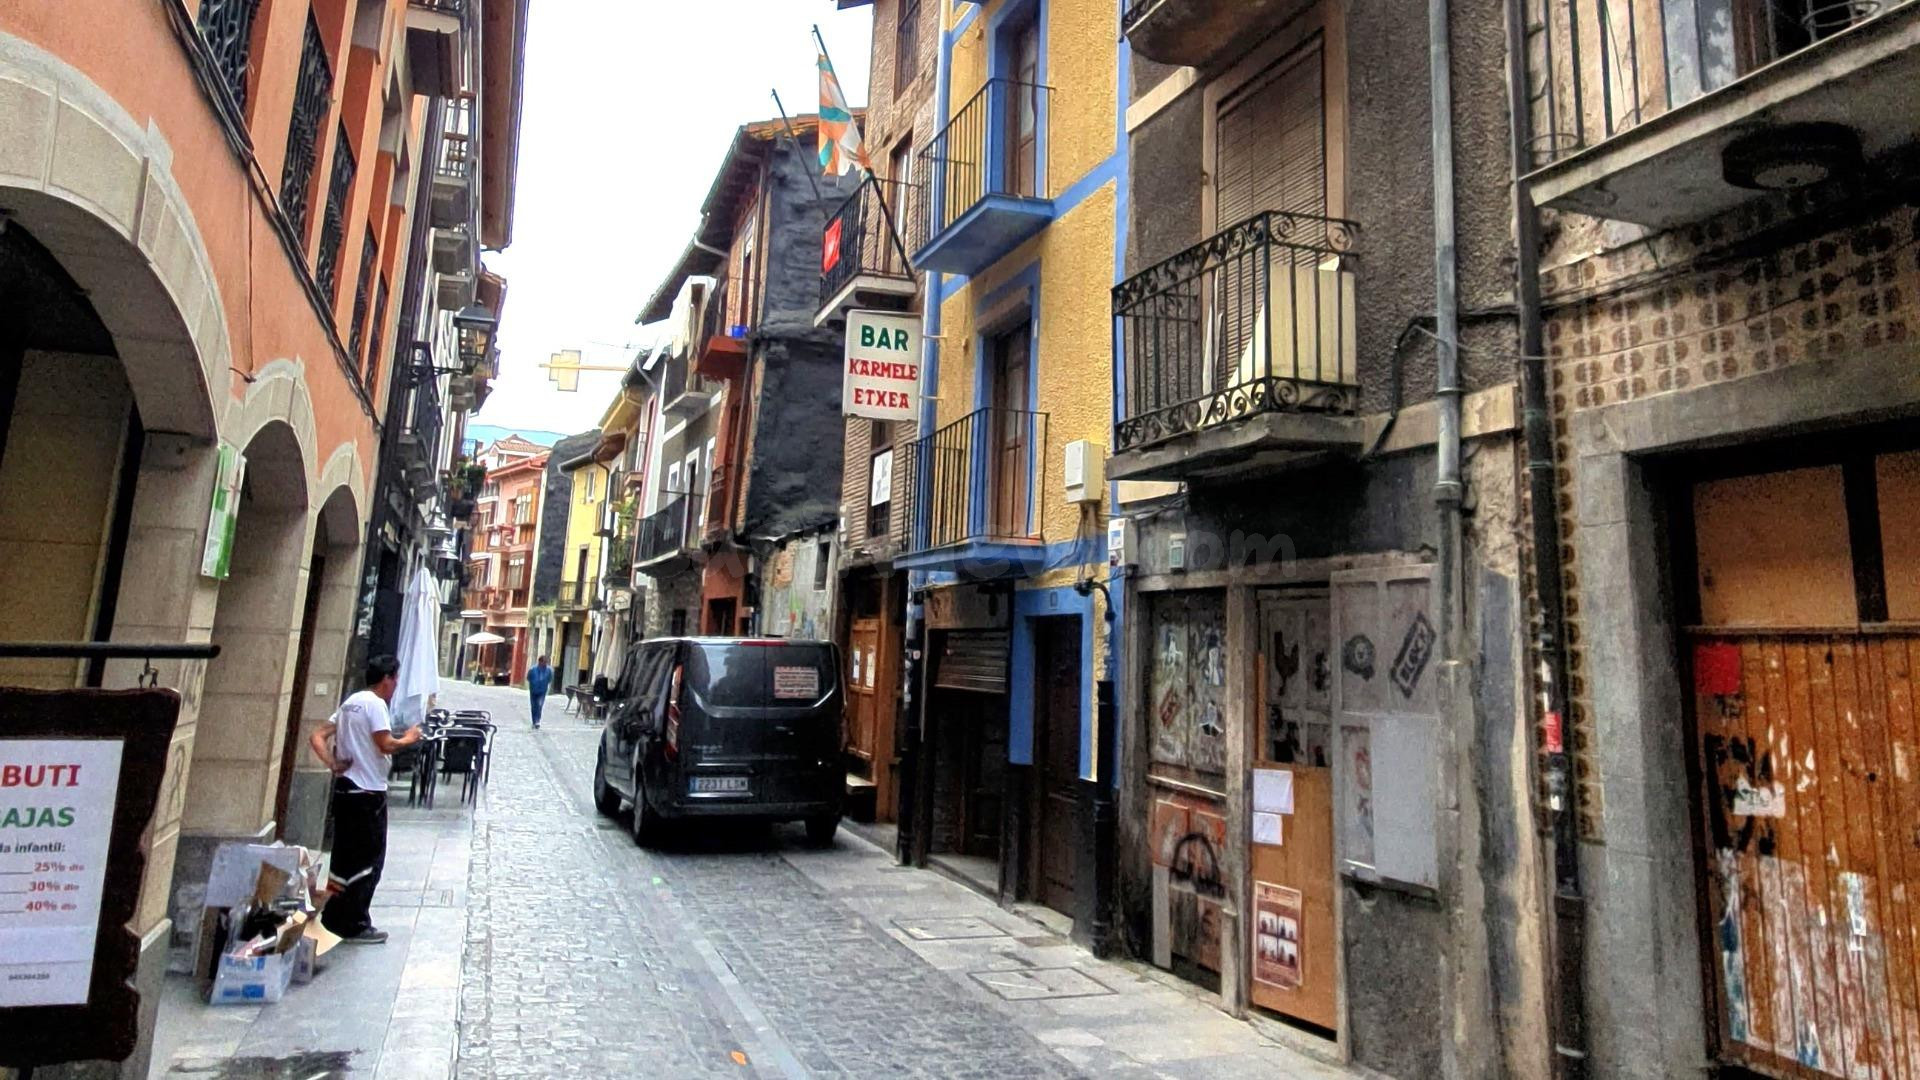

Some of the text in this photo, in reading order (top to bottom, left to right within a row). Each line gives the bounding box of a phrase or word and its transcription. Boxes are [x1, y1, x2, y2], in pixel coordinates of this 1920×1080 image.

[861, 324, 909, 351] BAR
[849, 358, 918, 381] KARMELE
[854, 387, 910, 409] ETXEA
[1, 764, 82, 787] BUTI
[0, 806, 75, 828] AJAS
[15, 841, 66, 853] infantil:
[28, 880, 60, 892] 30%
[25, 900, 57, 911] 40%
